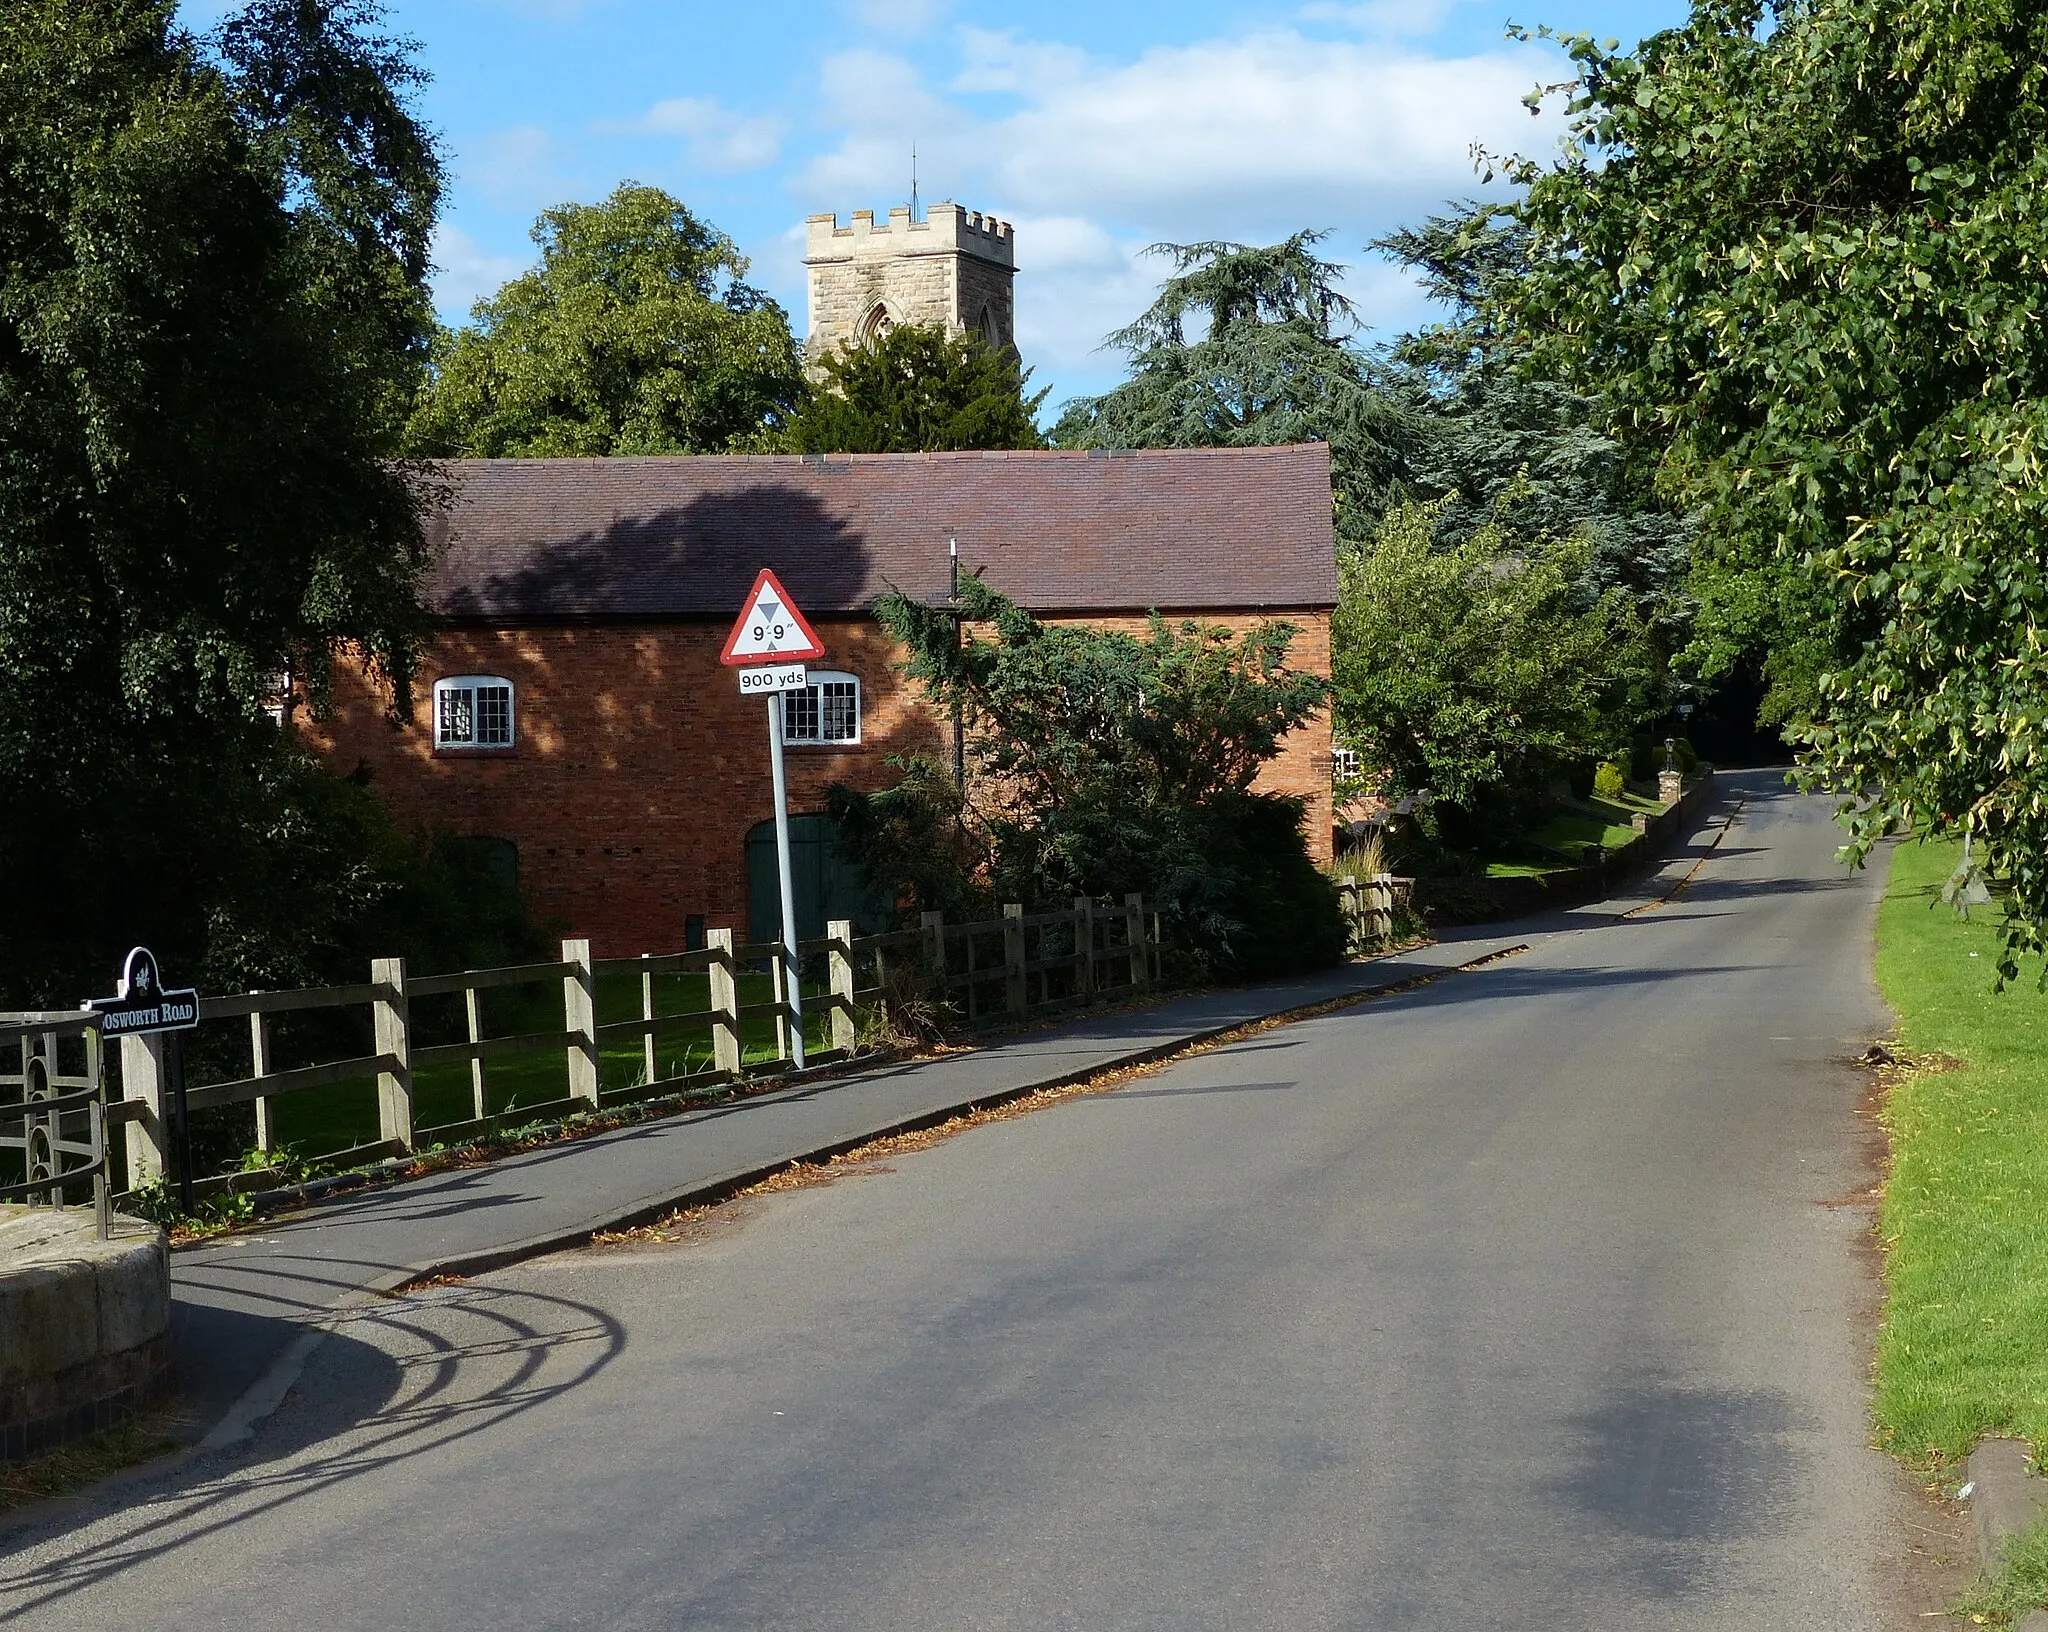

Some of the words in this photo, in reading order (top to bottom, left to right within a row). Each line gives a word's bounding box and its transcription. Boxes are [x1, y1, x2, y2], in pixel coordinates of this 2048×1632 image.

[742, 673, 773, 688] 900
[779, 671, 804, 687] yds
[103, 1008, 159, 1030] OSWORTH
[161, 1003, 193, 1022] ROAD
